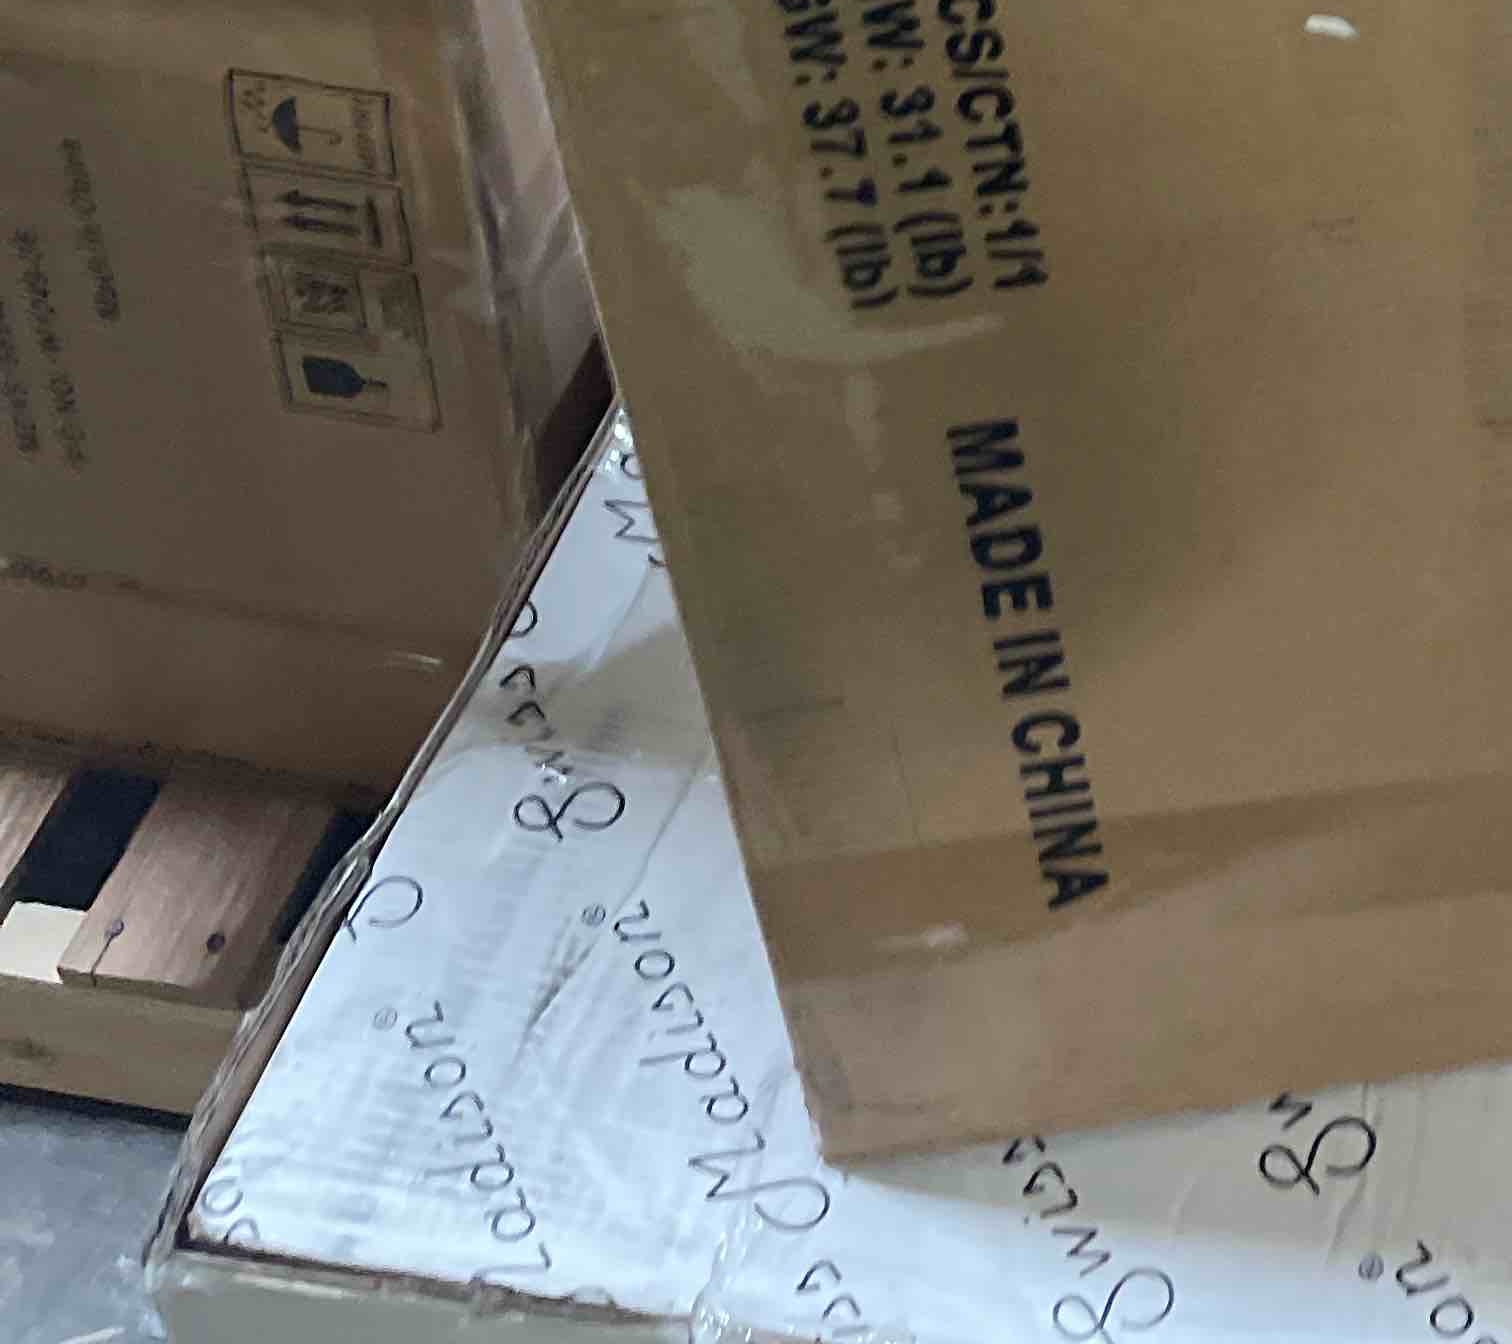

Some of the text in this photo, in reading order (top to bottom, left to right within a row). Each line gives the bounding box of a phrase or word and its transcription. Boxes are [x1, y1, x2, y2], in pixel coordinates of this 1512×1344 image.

[946, 416, 1110, 912] MADE IN CHINA
[613, 899, 831, 1231] Madison
